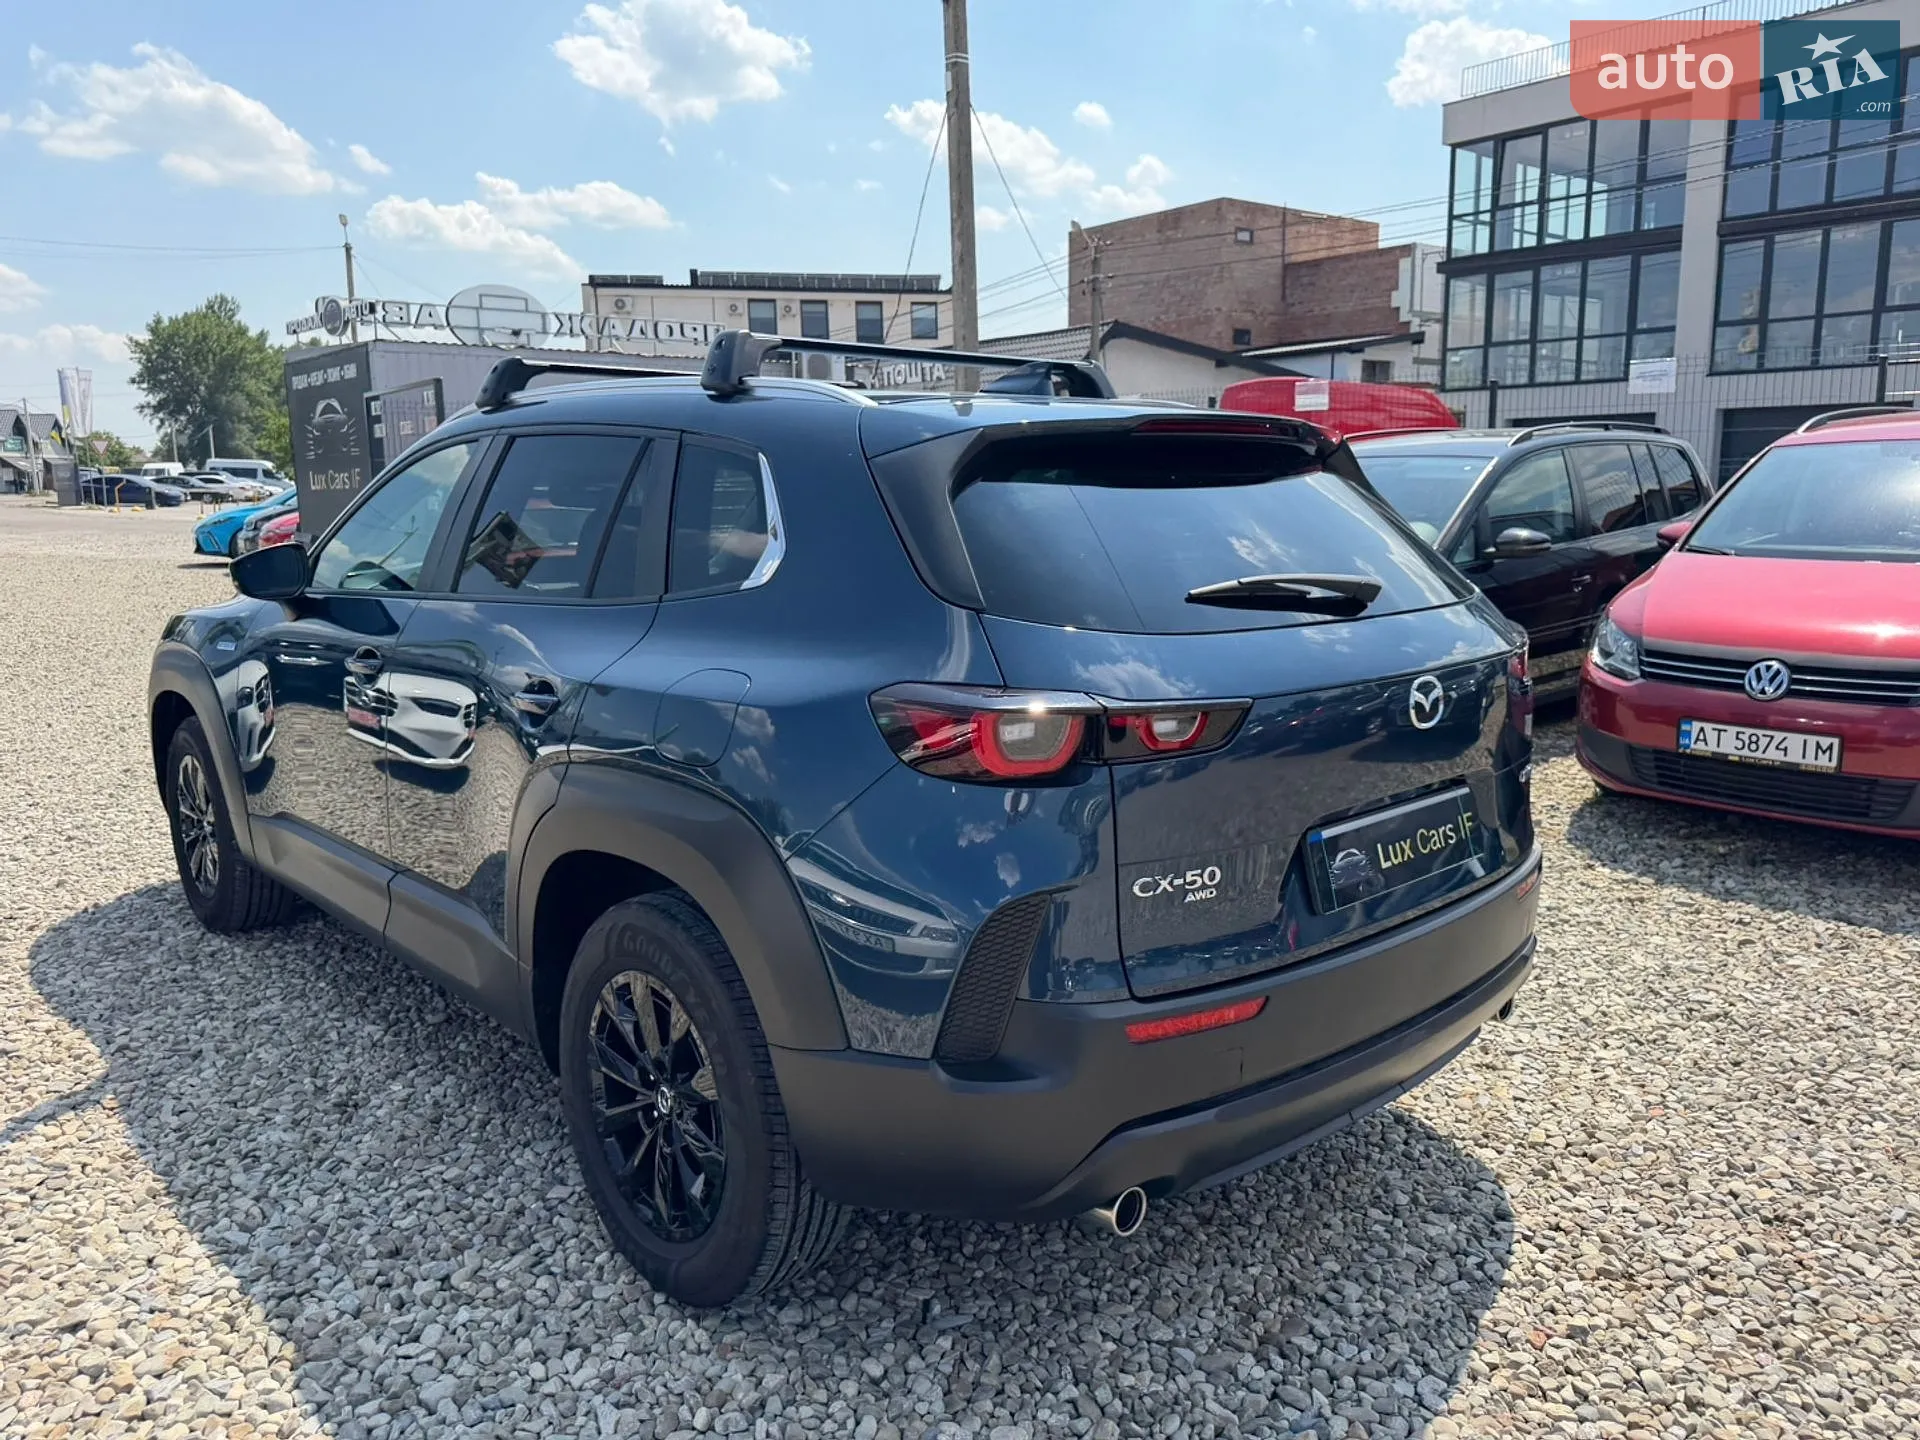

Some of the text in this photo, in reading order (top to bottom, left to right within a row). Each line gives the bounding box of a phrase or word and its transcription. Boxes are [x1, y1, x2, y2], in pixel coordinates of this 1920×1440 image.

[882, 361, 946, 386] ПОШТА
[310, 471, 327, 490] Lux
[328, 469, 350, 489] Cars
[1694, 726, 1727, 748] AT
[1735, 731, 1788, 757] 5874
[1801, 738, 1834, 762] IM
[1376, 812, 1473, 869] Lux Cars IF
[1132, 866, 1222, 897] CX-50
[1184, 888, 1217, 902] AWD
